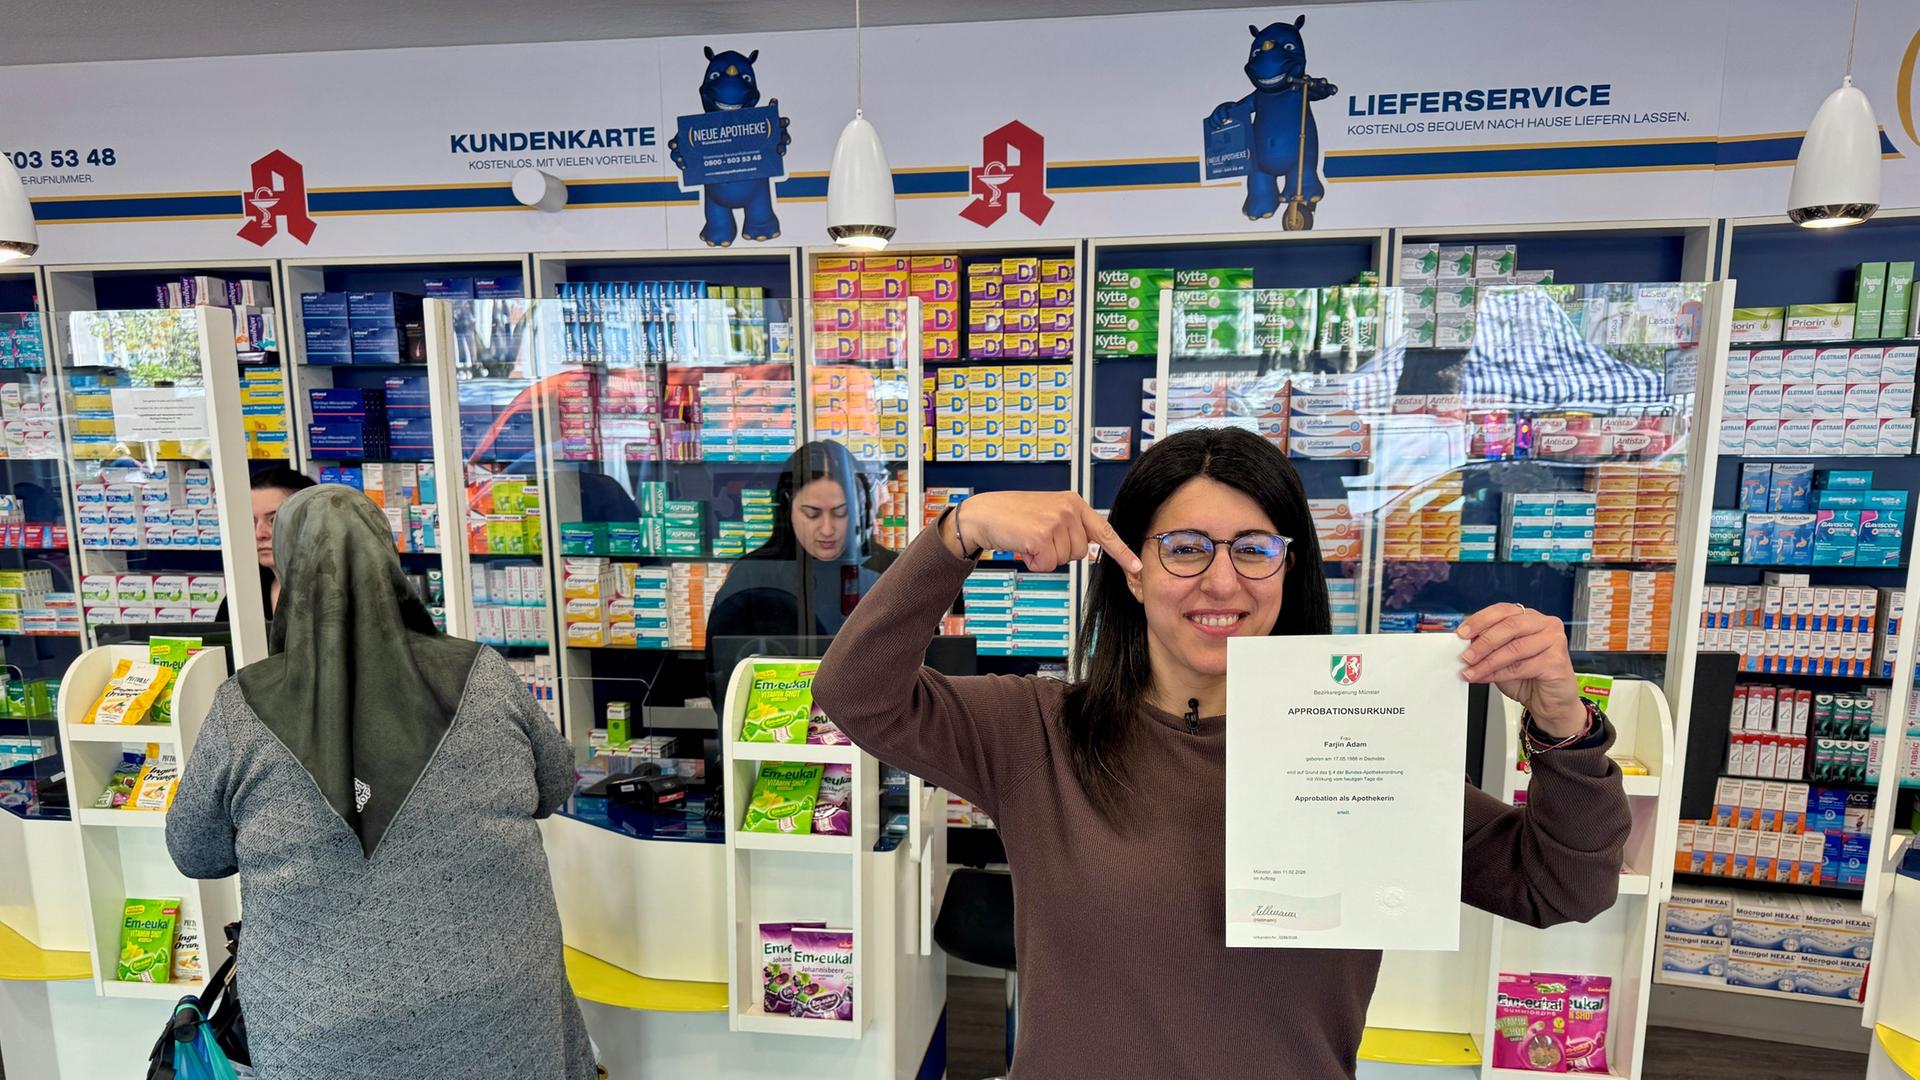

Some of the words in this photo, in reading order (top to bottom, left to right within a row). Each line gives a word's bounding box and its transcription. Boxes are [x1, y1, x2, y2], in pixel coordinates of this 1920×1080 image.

[1348, 83, 1611, 116] LIEFERSERVICE
[1347, 121, 1425, 136] KOSTENLOS
[1427, 119, 1484, 133] BEQUEM
[1487, 117, 1526, 131] NACH
[1527, 115, 1573, 129] HAUSE
[1574, 113, 1631, 126] LIEFERN
[1633, 111, 1691, 124] LASSEN.
[450, 126, 657, 154] KUNDENKARTE
[50, 149, 80, 168] 53
[87, 148, 117, 167] 48
[468, 158, 535, 170] KOSTENLOS.
[537, 157, 555, 168] MIT
[556, 156, 593, 167] VIELEN
[595, 154, 658, 166] VORTEILEN.
[1098, 271, 1129, 285] Kytta
[1177, 271, 1208, 285] Kytta
[1096, 291, 1127, 305] Kytta
[1095, 313, 1127, 327] Kytta
[1792, 319, 1825, 328] Priorin
[1095, 335, 1126, 348] Kytta
[671, 530, 696, 538] ASPIRIN
[1288, 707, 1406, 715] APPROBATIONSURKUNDE
[1324, 741, 1344, 749] Farjin
[1846, 794, 1868, 802] ACC
[1736, 908, 1773, 918] Macrogol
[1806, 915, 1844, 925] Macrogol
[1732, 948, 1769, 958] Macrogol
[1801, 956, 1839, 966] Macrogol
[801, 966, 844, 974] Johannisbeere
